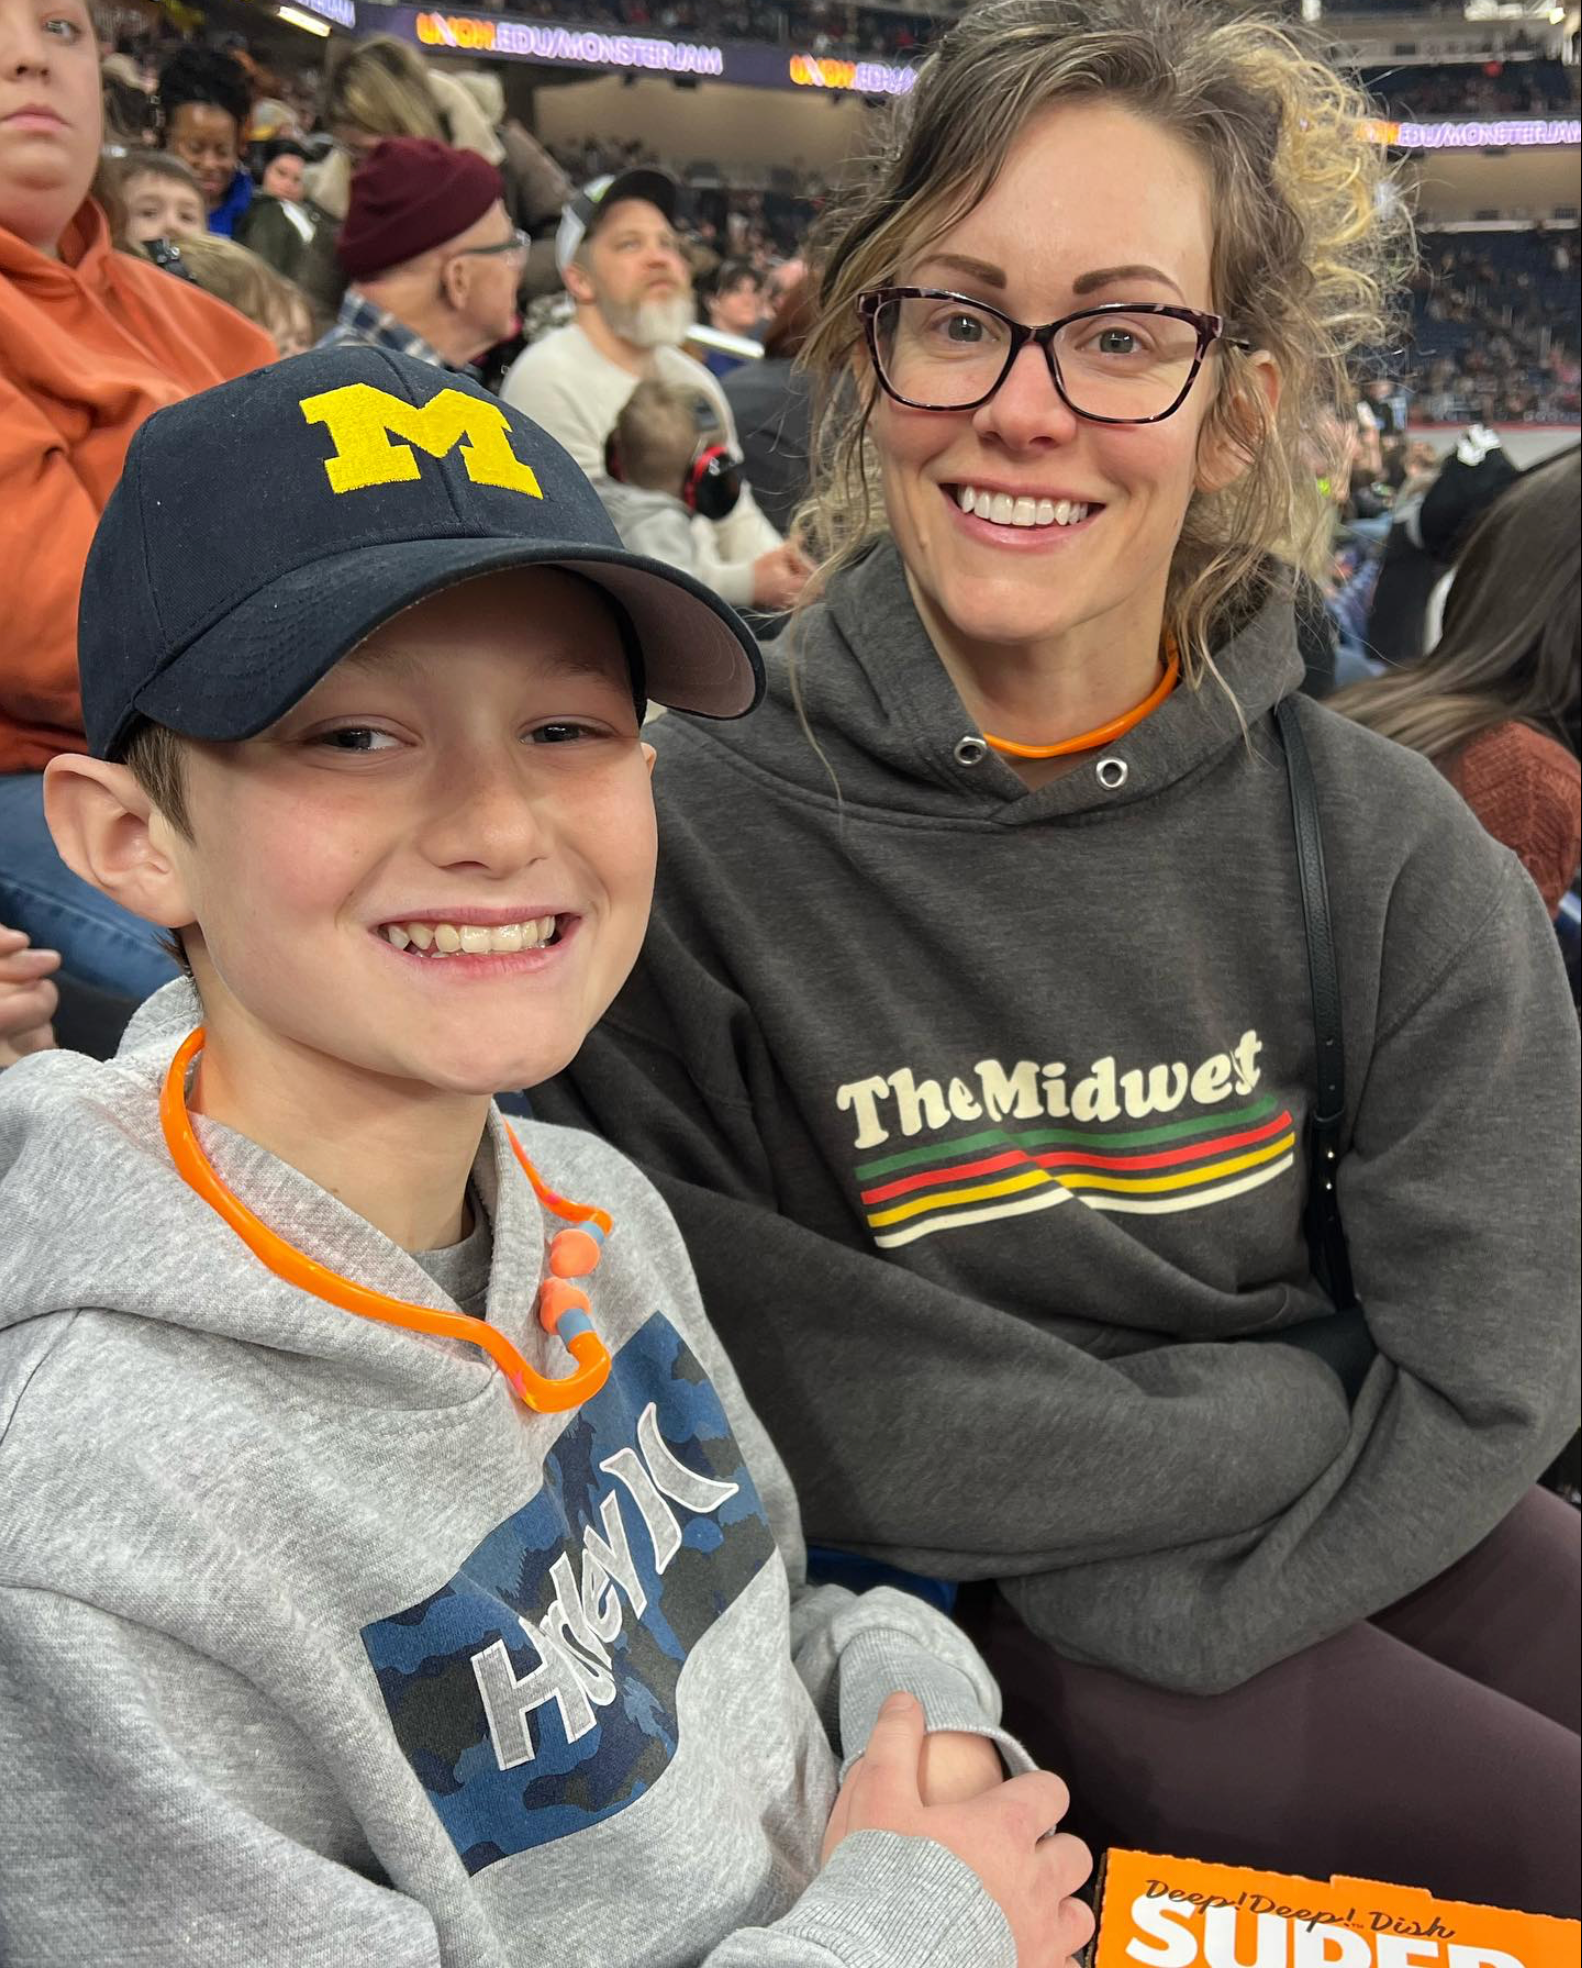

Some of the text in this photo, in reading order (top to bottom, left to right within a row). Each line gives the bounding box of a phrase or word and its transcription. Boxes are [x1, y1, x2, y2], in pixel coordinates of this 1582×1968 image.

[299, 382, 544, 500] M
[836, 1067, 983, 1149] The
[1369, 1911, 1456, 1939] Dish
